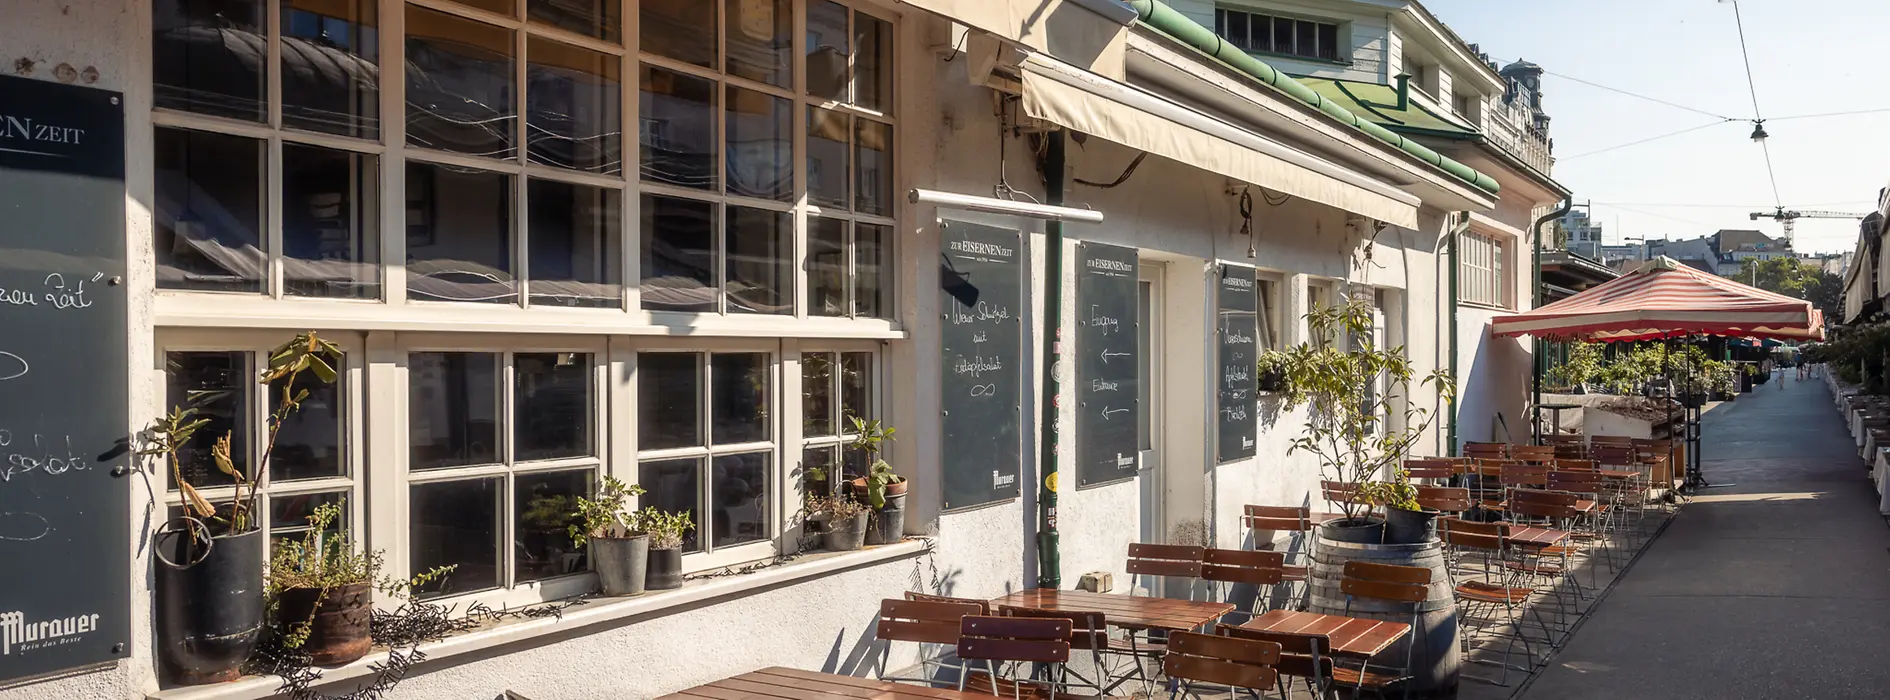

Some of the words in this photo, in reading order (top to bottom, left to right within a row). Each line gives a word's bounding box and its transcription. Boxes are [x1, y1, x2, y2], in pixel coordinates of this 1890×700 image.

[35, 124, 85, 144] ZEIT
[962, 240, 1002, 256] EISERNEN
[0, 610, 100, 655] Murauer
[20, 643, 40, 652] Rein
[42, 640, 57, 648] das
[60, 636, 82, 645] Beste
